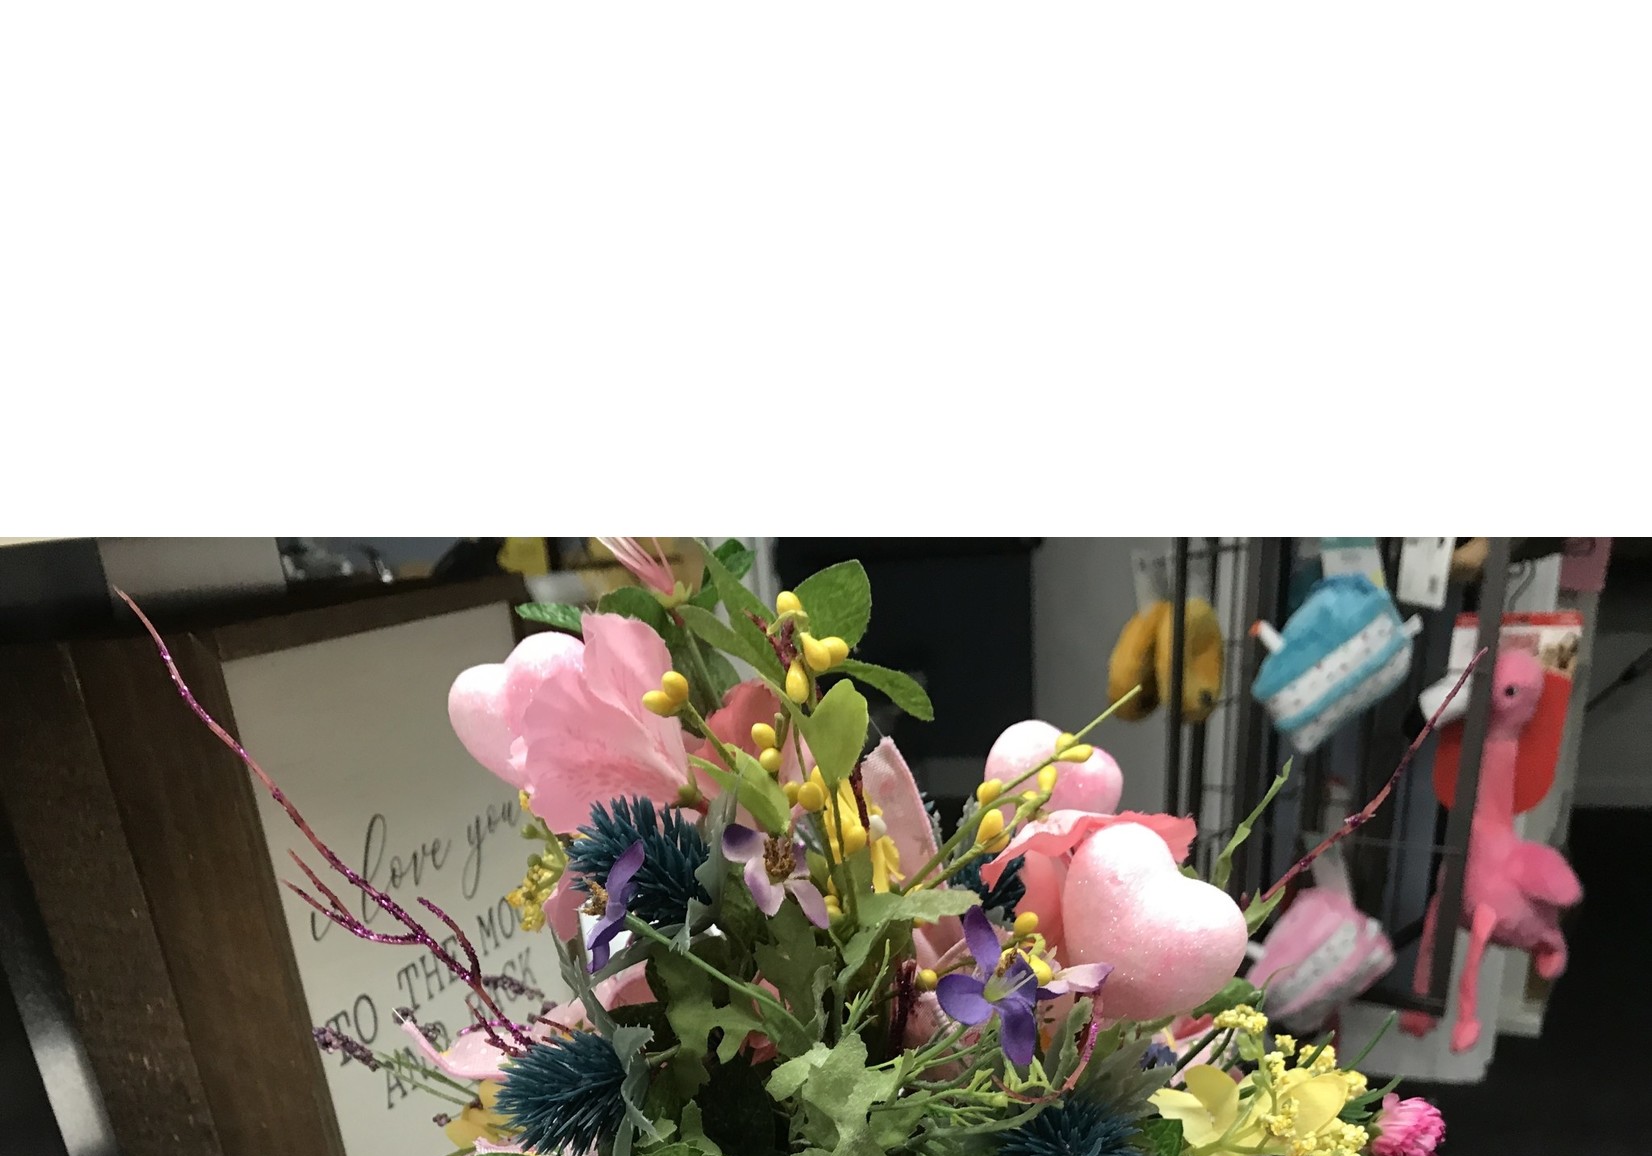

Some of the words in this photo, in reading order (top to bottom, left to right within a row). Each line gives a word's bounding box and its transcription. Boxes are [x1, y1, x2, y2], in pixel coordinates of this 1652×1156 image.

[361, 813, 453, 924] love
[461, 799, 521, 900] you
[324, 993, 378, 1067] TO
[396, 934, 460, 1011] THE
